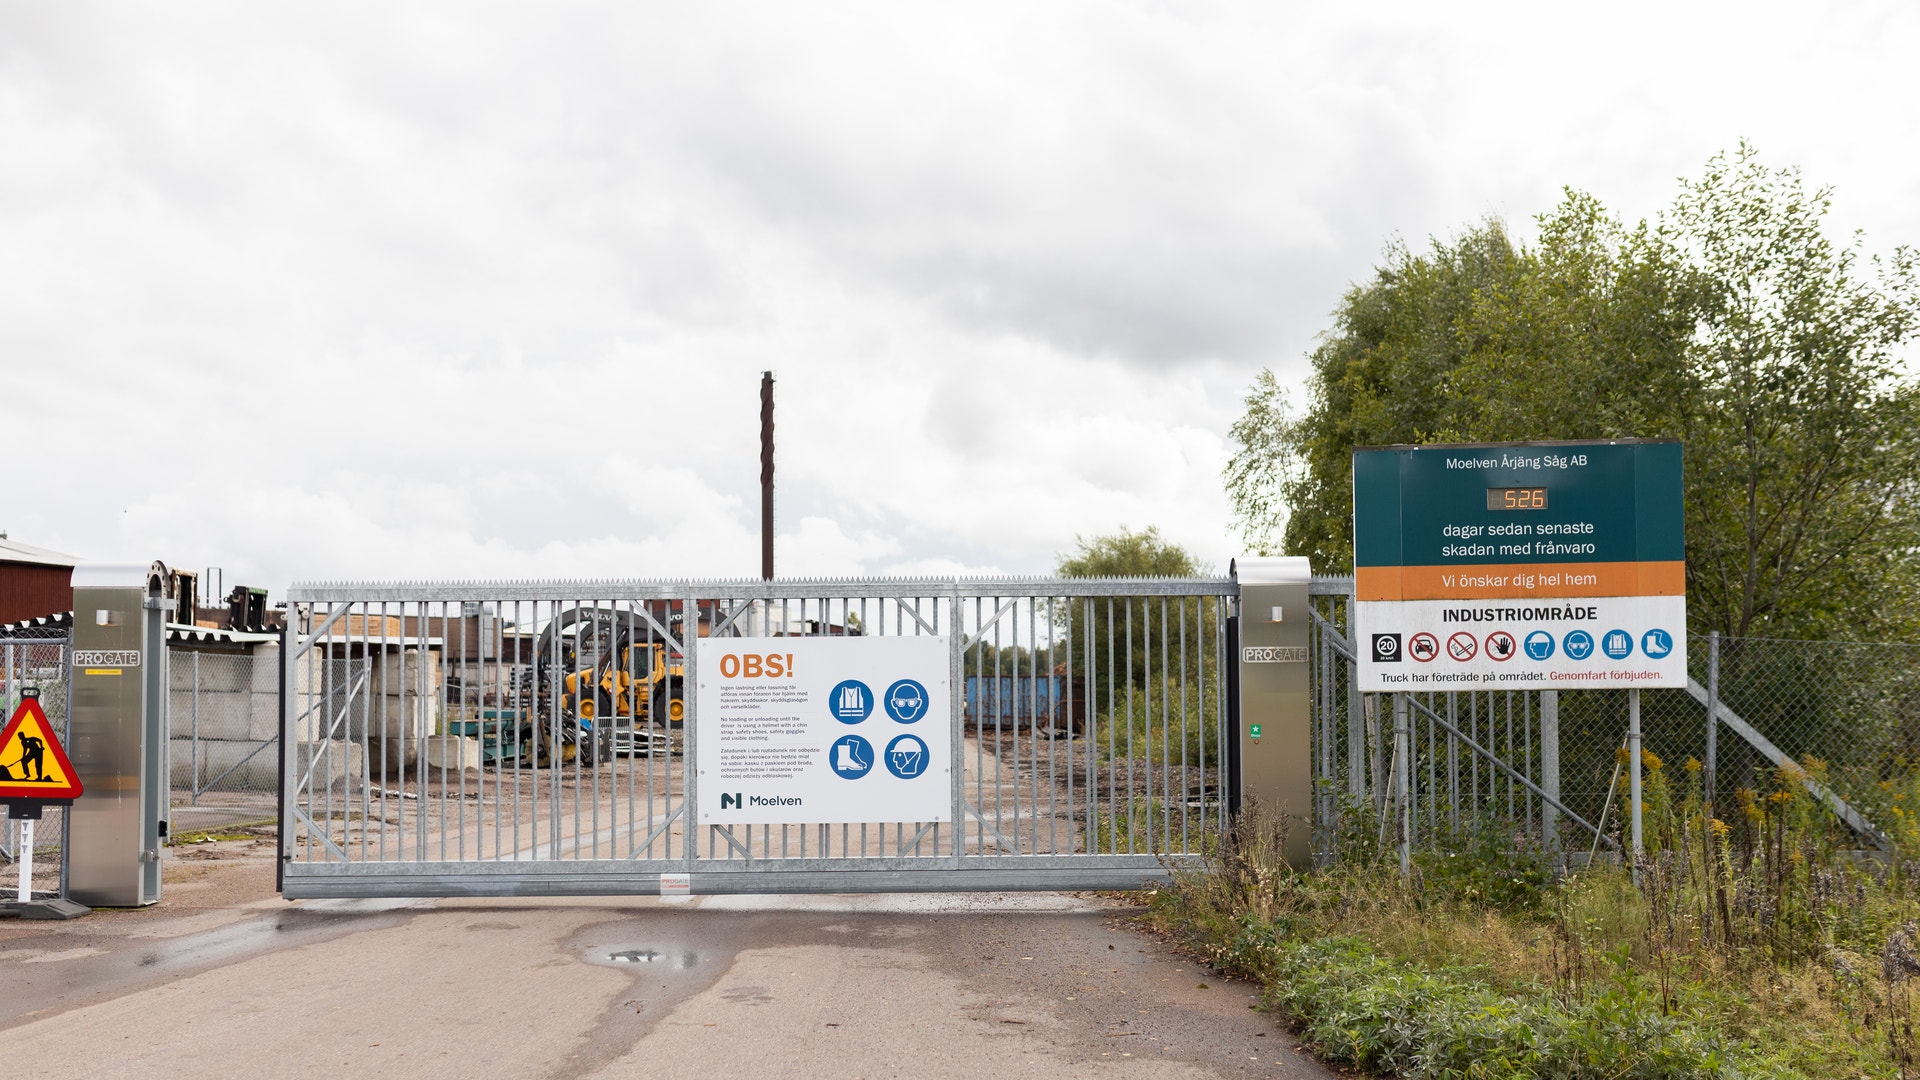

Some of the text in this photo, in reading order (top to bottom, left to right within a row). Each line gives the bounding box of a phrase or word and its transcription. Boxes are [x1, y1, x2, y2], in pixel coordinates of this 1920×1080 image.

[1446, 454, 1588, 469] Moelven Årjäng Såg AB
[1505, 491, 1544, 508] 526
[1443, 522, 1594, 538] dagar sedan senaste
[1442, 541, 1595, 556] skadan med frånvaro
[1442, 573, 1597, 589] Vi önskar dig hel hem
[1443, 603, 1598, 623] INDUSTRIOMRÅDE
[1380, 641, 1394, 650] 20
[76, 653, 137, 665] PROGATE
[1246, 650, 1306, 661] PROGATE
[720, 654, 793, 678] OBS!
[1381, 670, 1663, 683] Truck har företräde på området. Genomfart förbjuden.
[750, 796, 802, 806] Moelven
